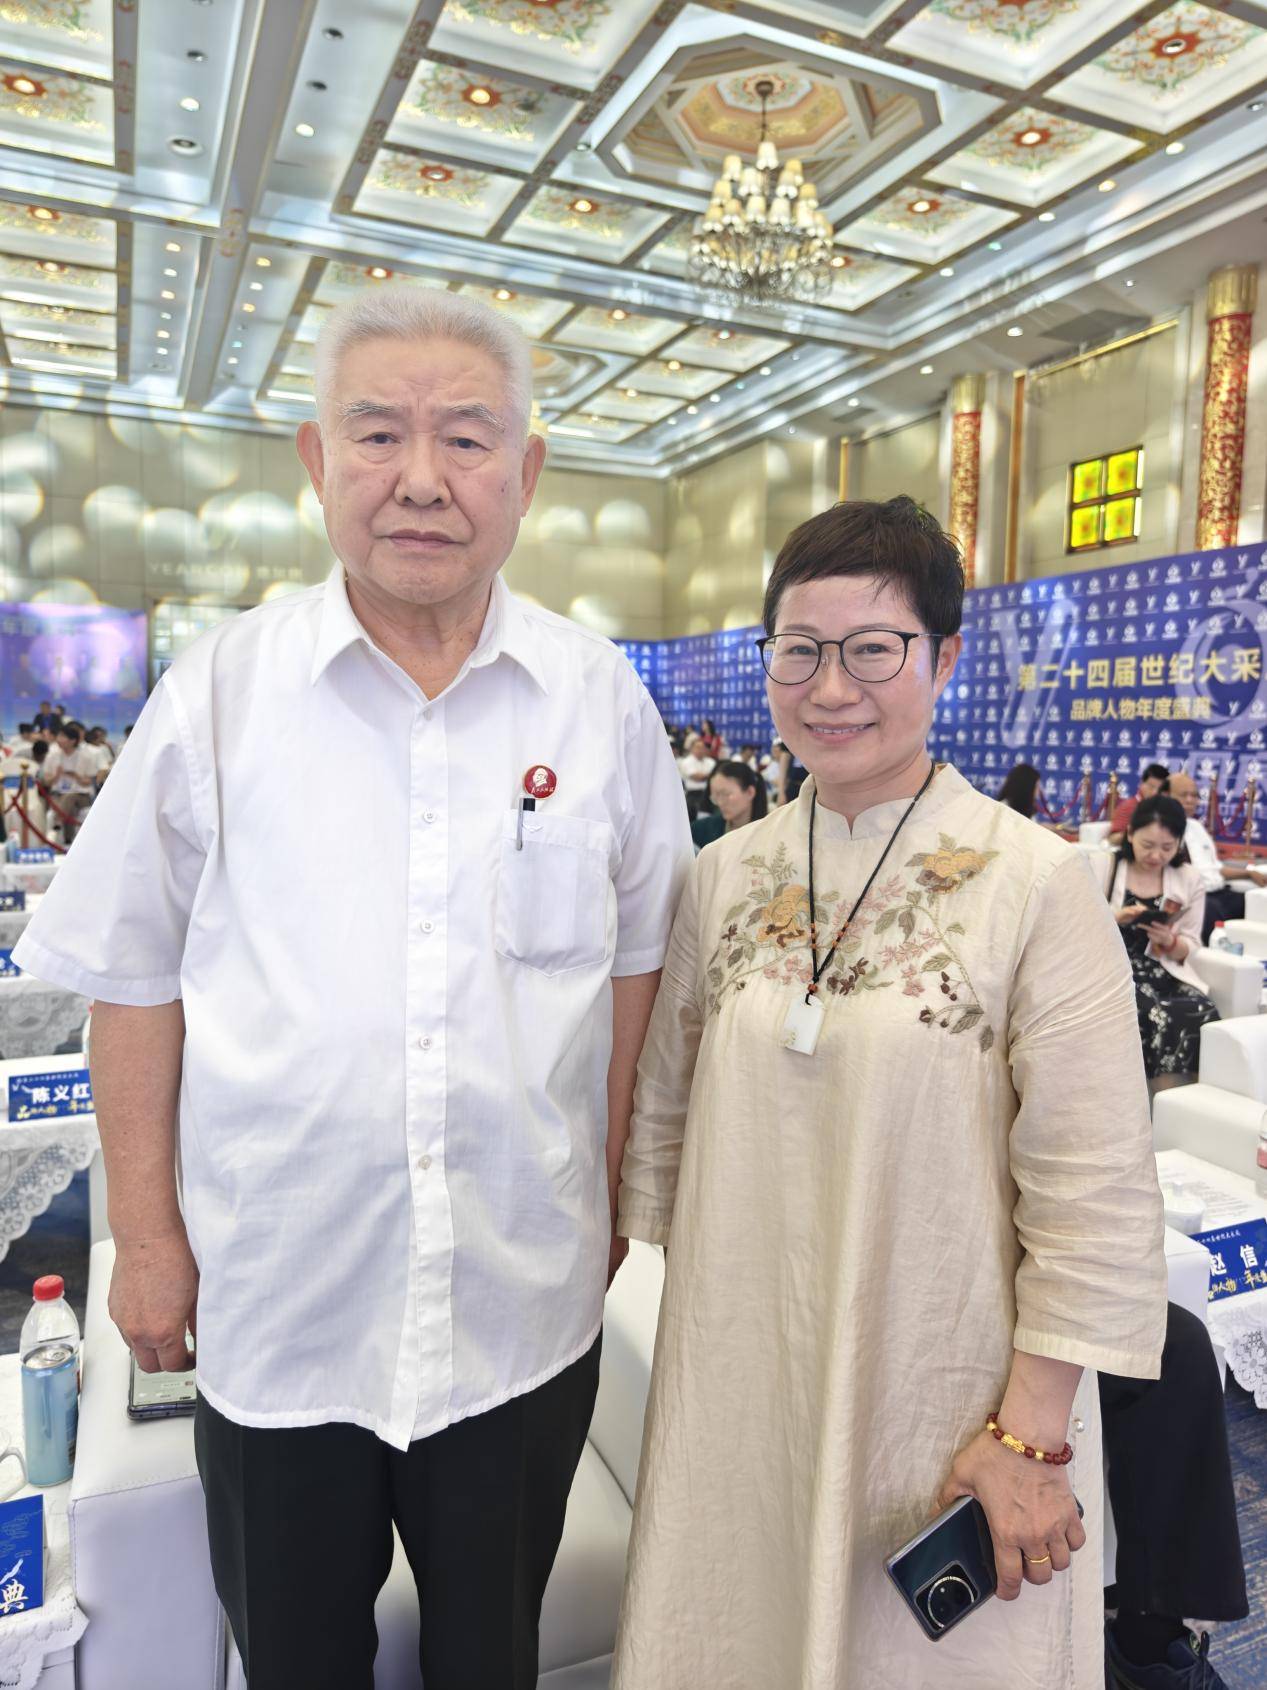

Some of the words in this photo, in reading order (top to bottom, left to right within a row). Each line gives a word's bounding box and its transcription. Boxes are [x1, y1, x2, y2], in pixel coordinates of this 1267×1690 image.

[1018, 647, 1267, 692] 第二十四届世纪大采
[0, 1578, 29, 1614] 典
